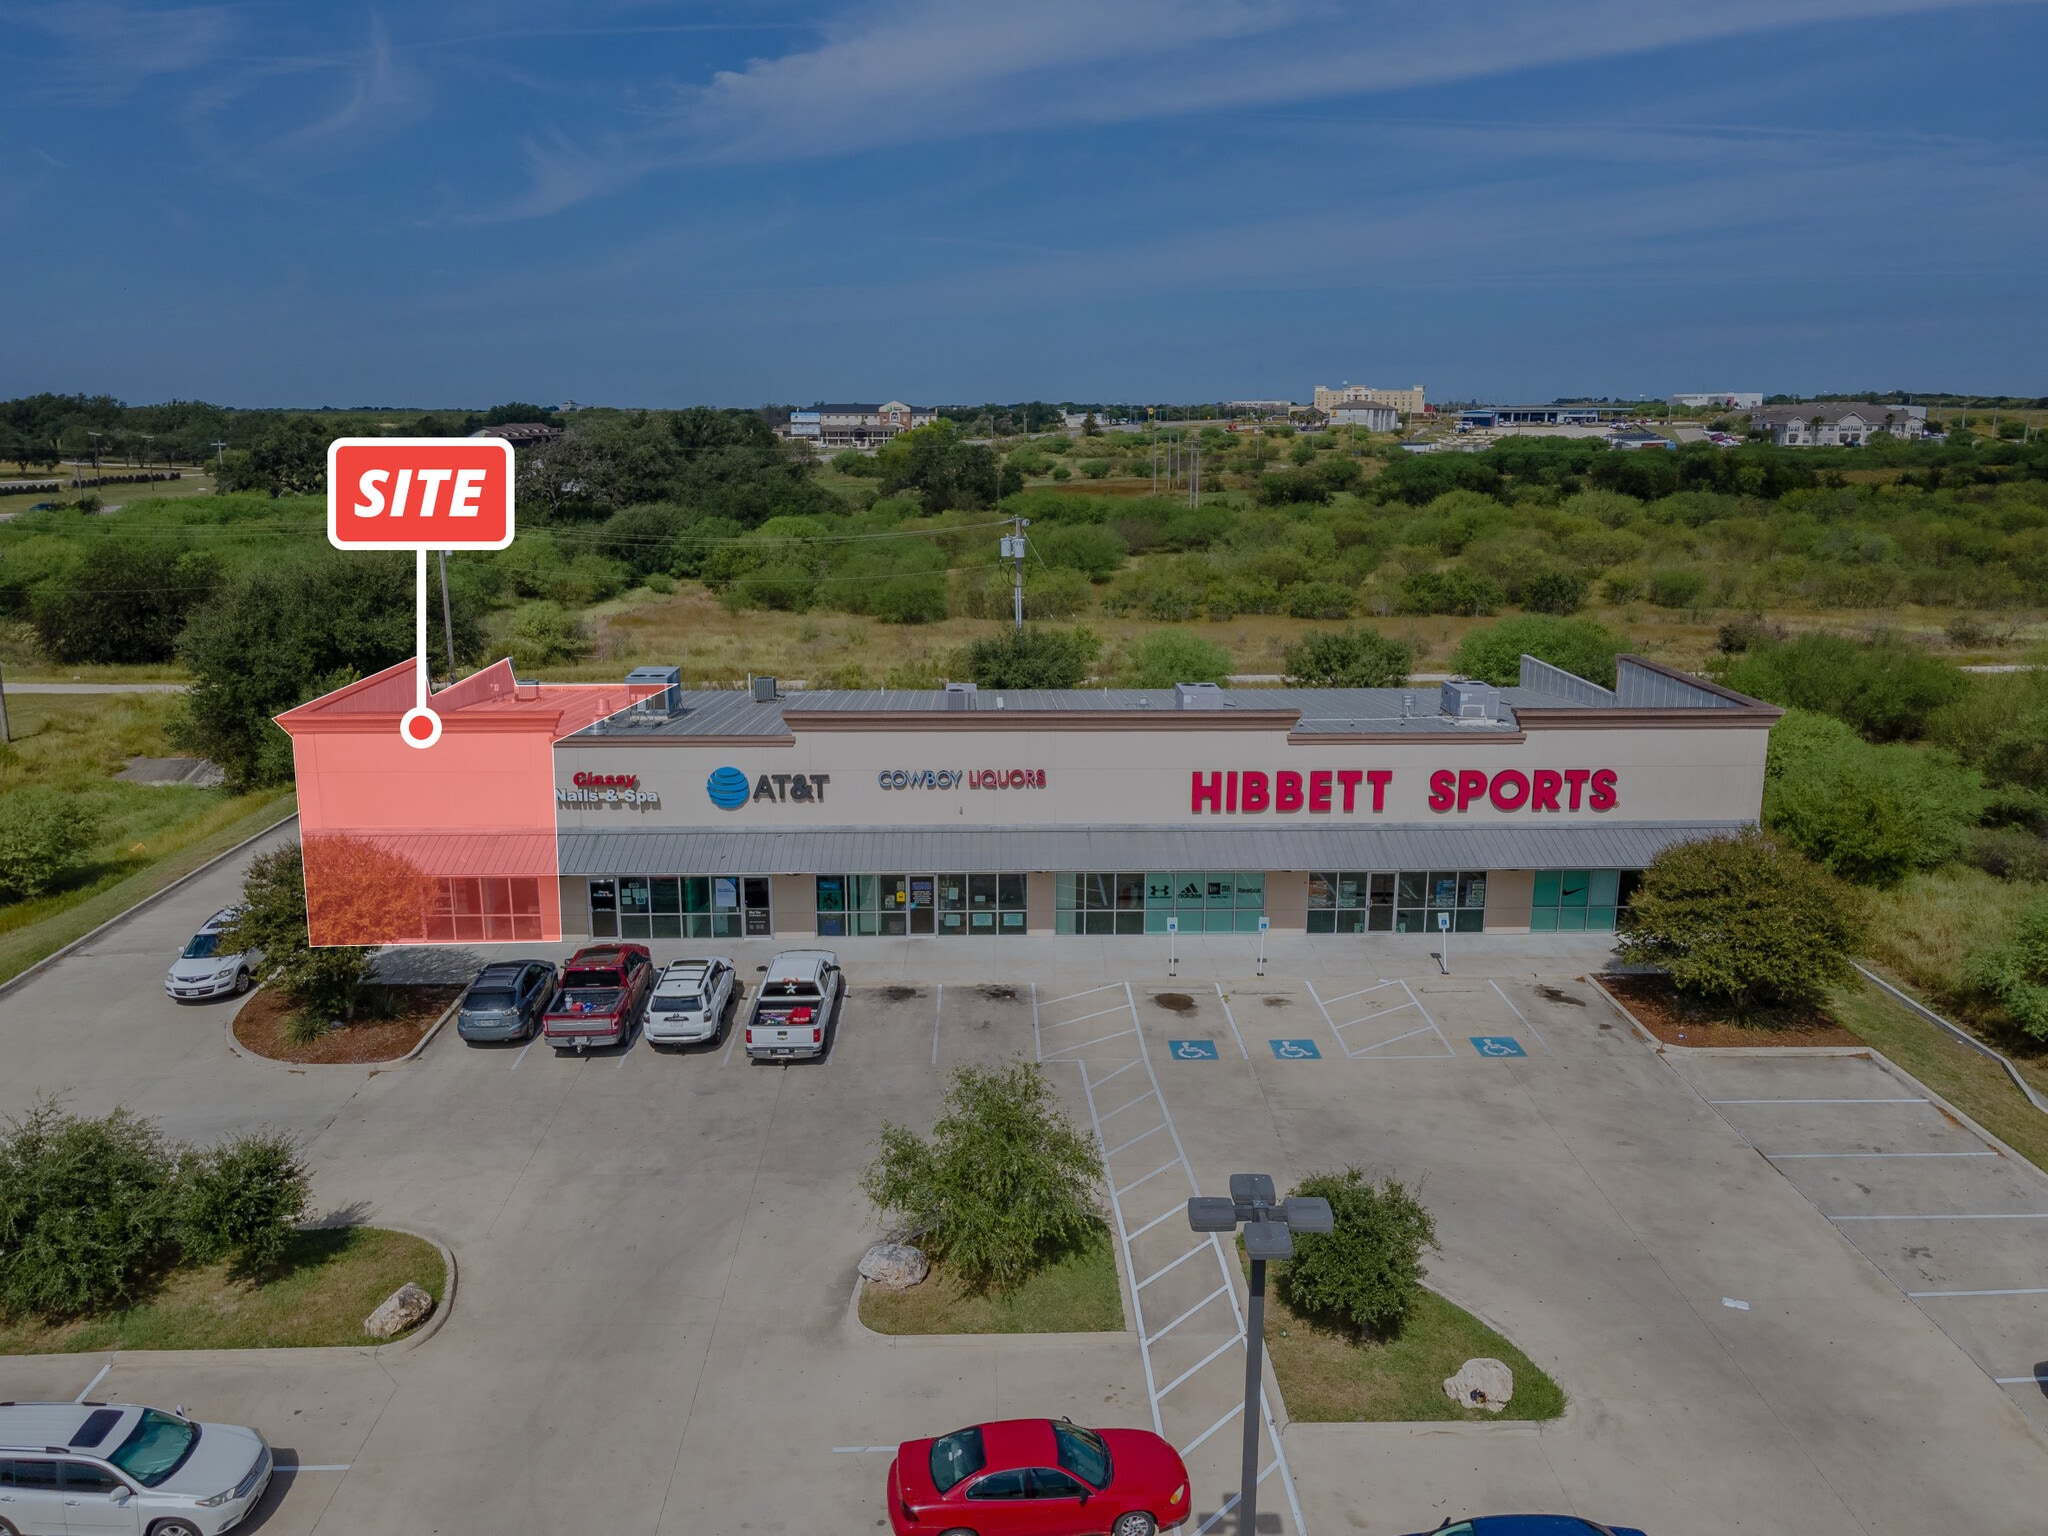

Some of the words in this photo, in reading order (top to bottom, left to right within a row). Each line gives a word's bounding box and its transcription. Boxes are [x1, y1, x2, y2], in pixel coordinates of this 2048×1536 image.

[573, 771, 637, 788] Classy
[752, 774, 830, 802] AT&T
[879, 769, 962, 789] COWBOY
[968, 769, 1047, 789] LIQUORS
[555, 788, 599, 802] Nails
[604, 789, 619, 802] &
[624, 789, 658, 805] Spa
[1191, 770, 1393, 813] HIBBETT
[1428, 769, 1619, 813] SPORTS
